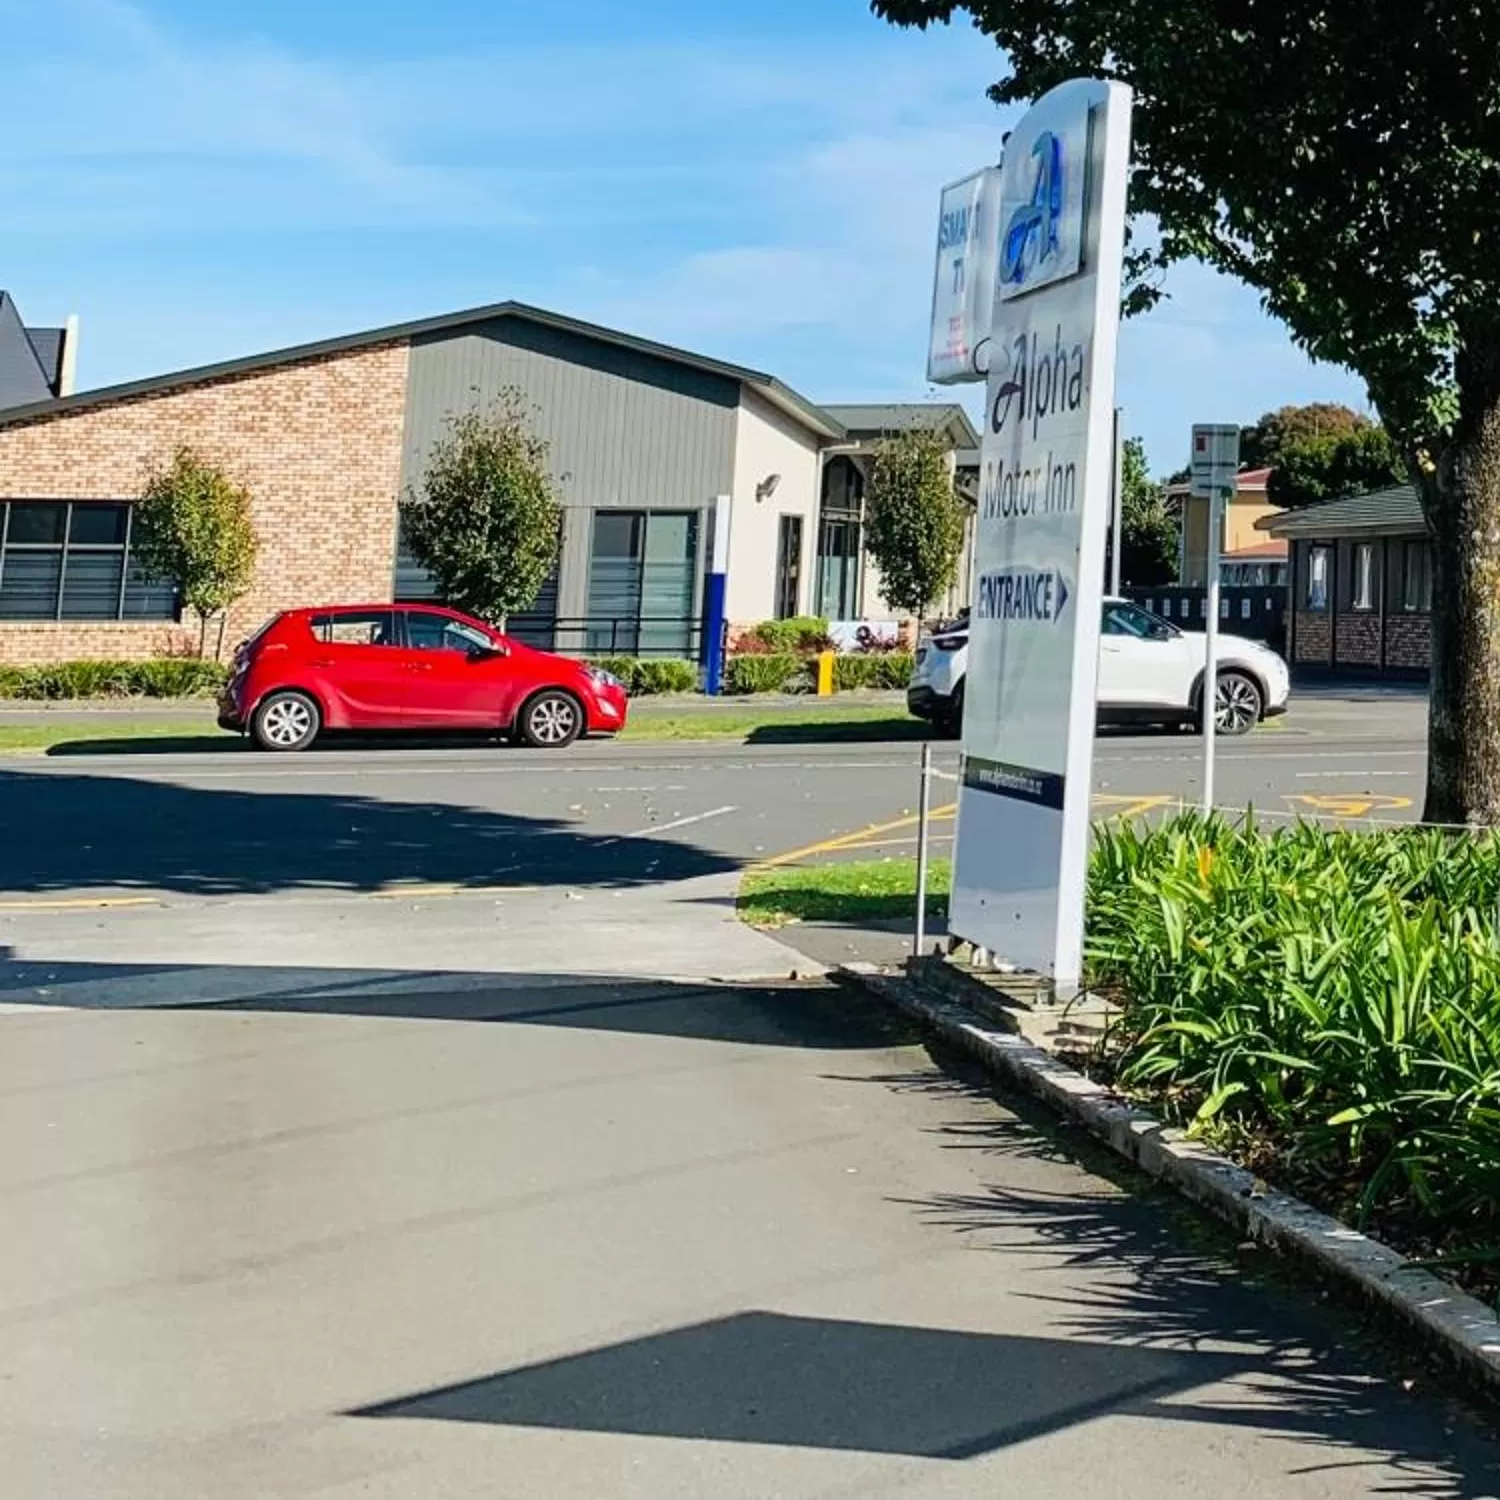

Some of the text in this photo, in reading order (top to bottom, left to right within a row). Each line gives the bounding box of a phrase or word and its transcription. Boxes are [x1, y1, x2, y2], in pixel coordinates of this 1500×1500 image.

[991, 323, 1083, 441] Alpha
[983, 451, 1075, 520] Motor Inn
[978, 571, 1053, 620] ENTRANCE
